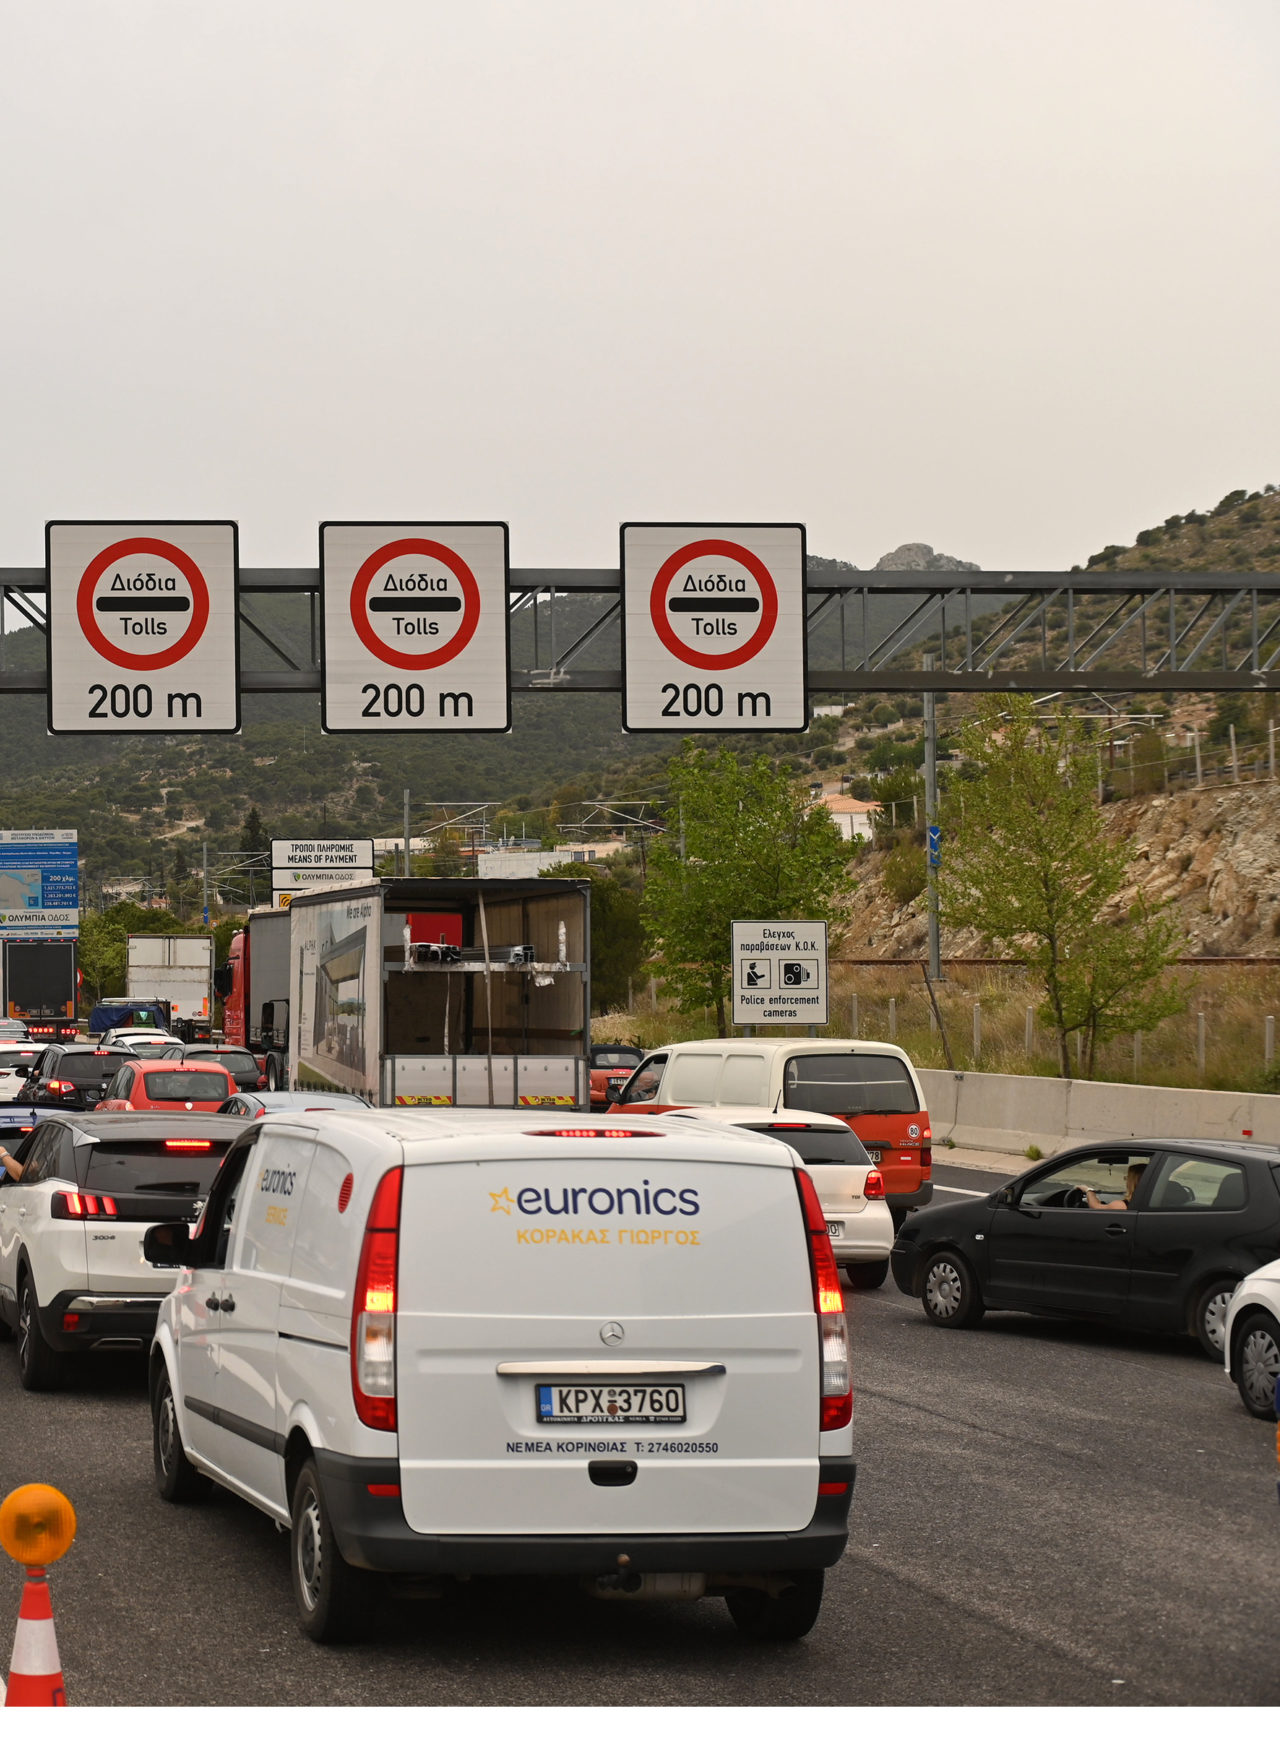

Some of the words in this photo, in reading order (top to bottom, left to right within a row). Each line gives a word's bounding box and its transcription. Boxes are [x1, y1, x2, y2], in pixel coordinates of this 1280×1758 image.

[110, 573, 176, 591] Διόδια
[384, 574, 447, 591] Διόδια
[683, 575, 745, 592] Διόδια
[120, 618, 167, 635] Tolls
[392, 618, 439, 634] Tolls
[691, 618, 738, 635] Tolls
[88, 684, 152, 718] 200
[168, 693, 202, 718] m
[362, 684, 424, 717] 200
[440, 692, 473, 716] m
[661, 683, 723, 716] 200
[738, 692, 771, 716] m
[291, 844, 315, 852] ΤΡΟΠΟΙ
[288, 854, 312, 864] MEANS
[314, 854, 322, 864] OF
[325, 854, 357, 864] PAYMENT
[763, 928, 795, 940] Ελεγχος
[740, 941, 791, 953] παραβάσεων
[740, 995, 765, 1004] Police
[769, 995, 819, 1004] enforcement
[763, 1009, 797, 1017] cameras
[261, 1164, 296, 1195] euronics
[516, 1179, 700, 1216] euronics
[516, 1229, 610, 1244] ΚΟΡΑΚΑΣ
[618, 1230, 700, 1245] ΓΙΩΡΓΟΣ
[507, 1442, 552, 1453] ΝΕΜΕΑ
[556, 1442, 627, 1453] ΚΟΡΙΝΘΙΑΣ
[648, 1442, 718, 1453] 2746020550
